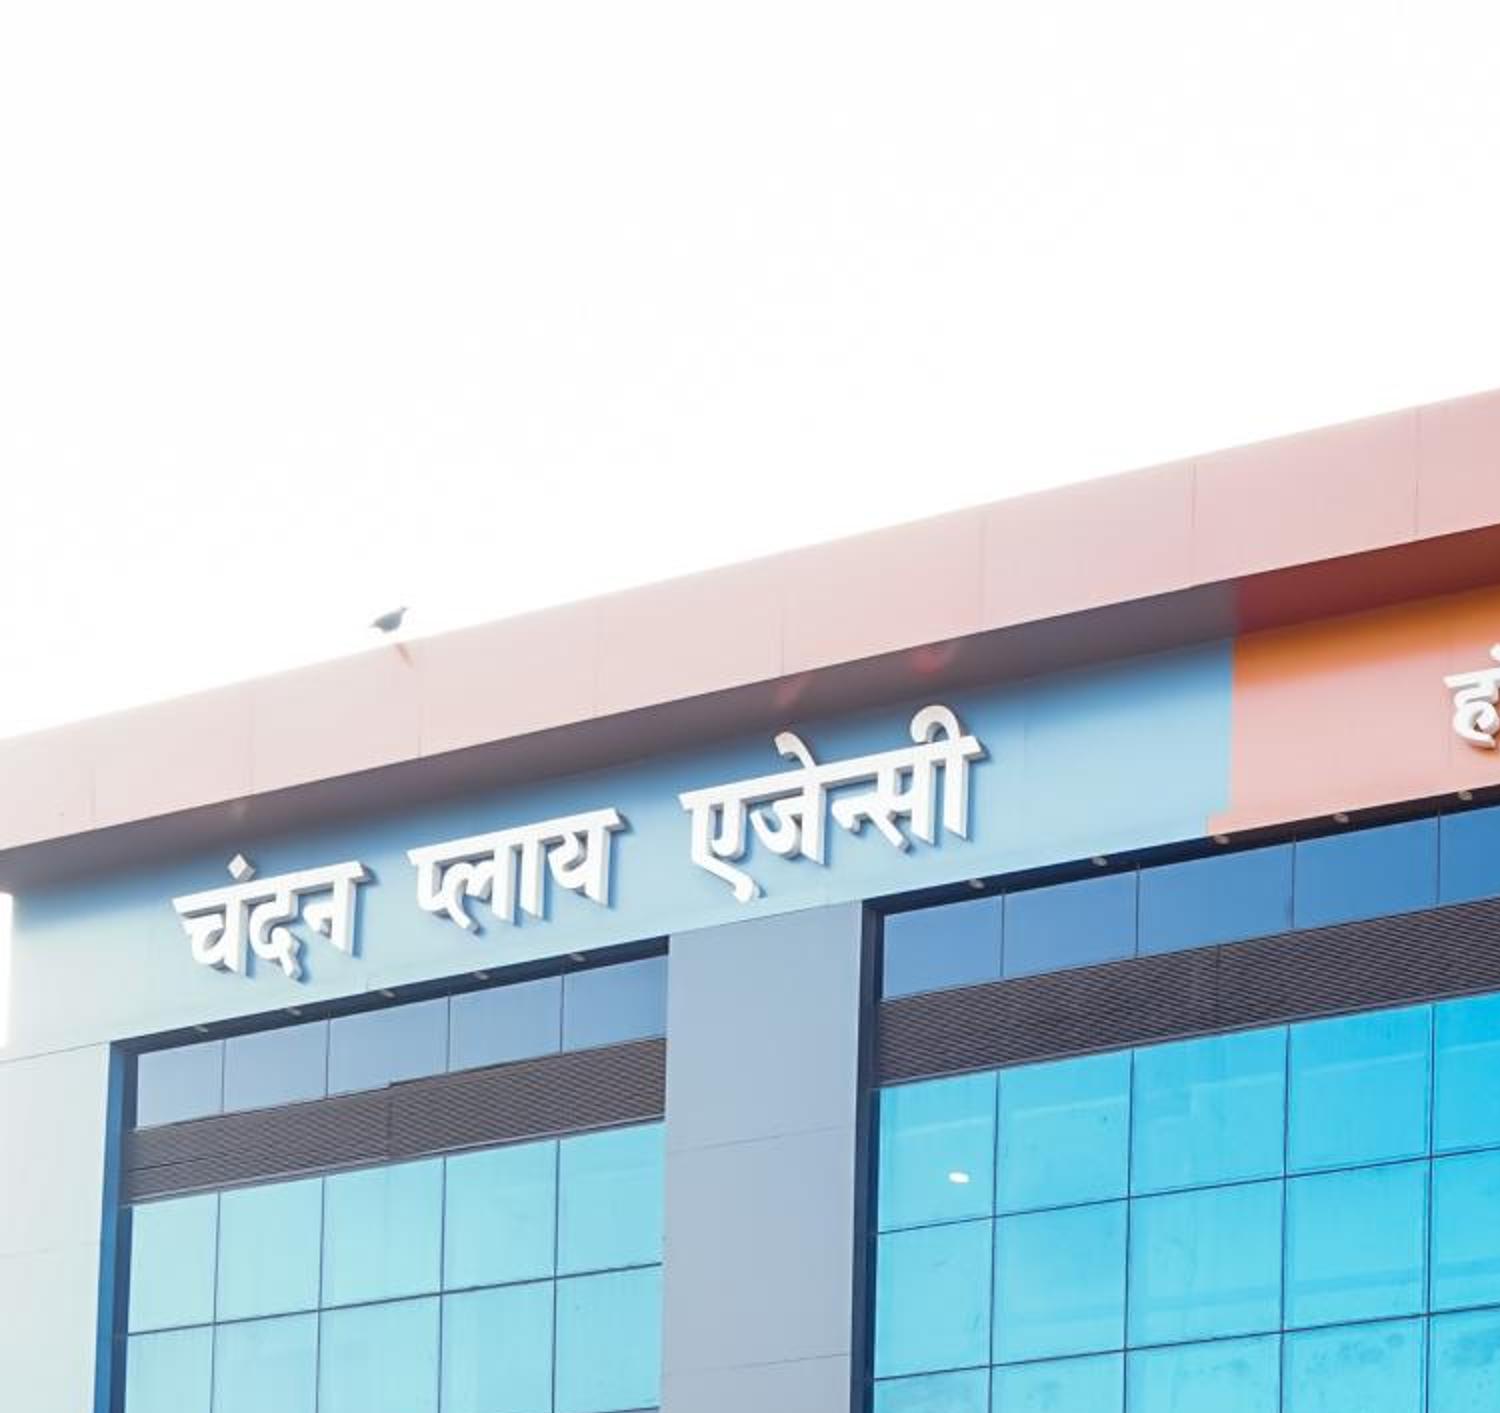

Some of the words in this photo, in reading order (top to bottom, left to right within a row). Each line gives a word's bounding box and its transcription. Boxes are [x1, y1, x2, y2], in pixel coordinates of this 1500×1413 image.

[171, 853, 371, 981] चंदन
[406, 808, 628, 935] प्लाय
[678, 705, 990, 904] एजेन्सी
